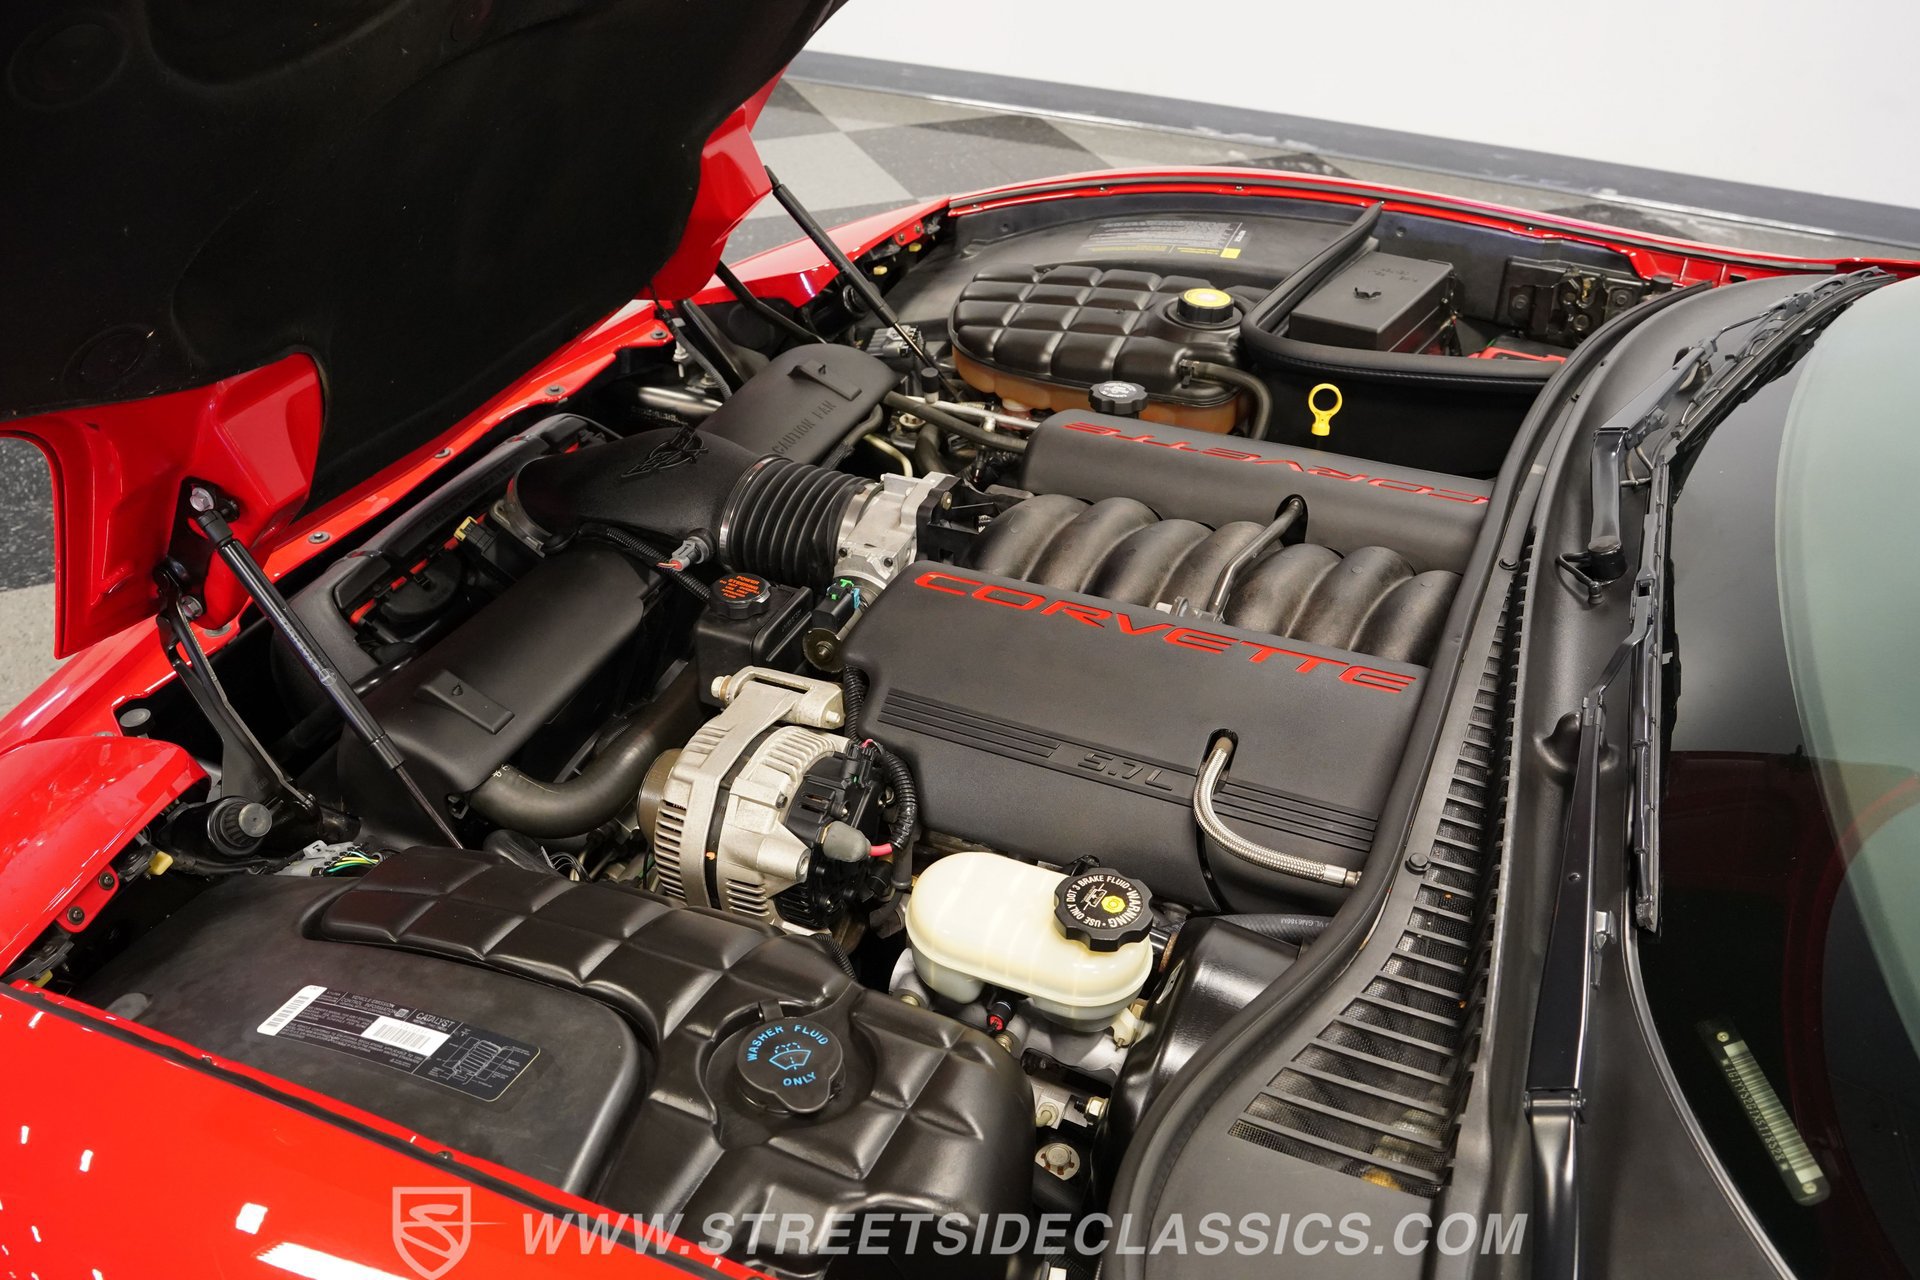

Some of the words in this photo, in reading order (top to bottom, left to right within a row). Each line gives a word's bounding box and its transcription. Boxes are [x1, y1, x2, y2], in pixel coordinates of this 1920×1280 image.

[772, 418, 815, 454] CAUTION
[811, 400, 837, 420] FAN
[1062, 421, 1490, 505] CORVETTE
[727, 578, 759, 590] STEERING
[736, 575, 760, 585] POWER
[913, 571, 1417, 694] CORVETTE
[1077, 751, 1174, 791] 5.7L
[1077, 874, 1105, 887] BRAKE
[1106, 875, 1131, 889] FLUID
[1066, 889, 1078, 902] DOT
[1067, 903, 1085, 920] ONLY
[1107, 889, 1141, 928] WARNING
[1083, 916, 1101, 928] USE
[415, 1012, 456, 1028] CATALYST
[747, 1025, 784, 1062] WASHER
[794, 1024, 829, 1045] FLUID
[783, 1071, 817, 1087] ONLY
